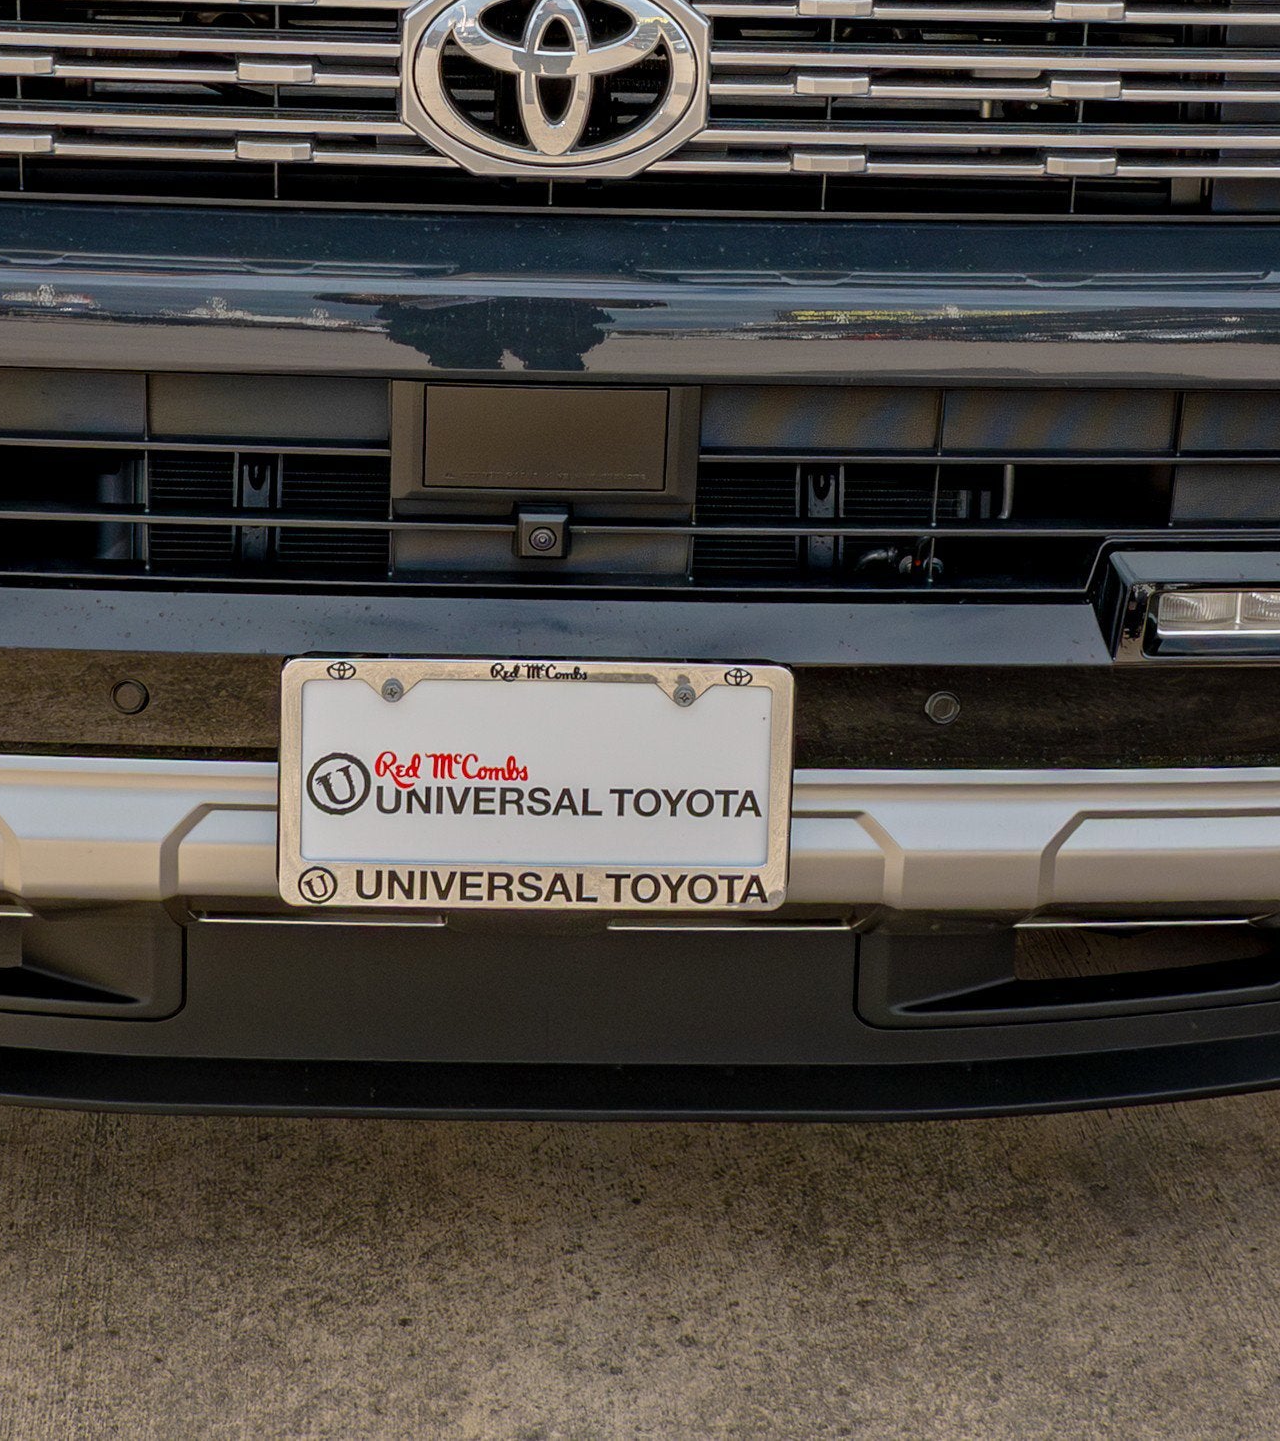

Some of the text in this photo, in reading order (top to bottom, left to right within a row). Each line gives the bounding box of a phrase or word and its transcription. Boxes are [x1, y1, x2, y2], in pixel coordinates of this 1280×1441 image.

[491, 662, 588, 682] Red McCombs
[375, 751, 528, 789] Red McCombs
[375, 786, 762, 818] UNIVERSAL TOYOTA
[355, 869, 598, 903] UNIVERSAL
[605, 873, 768, 904] TOYOTA
